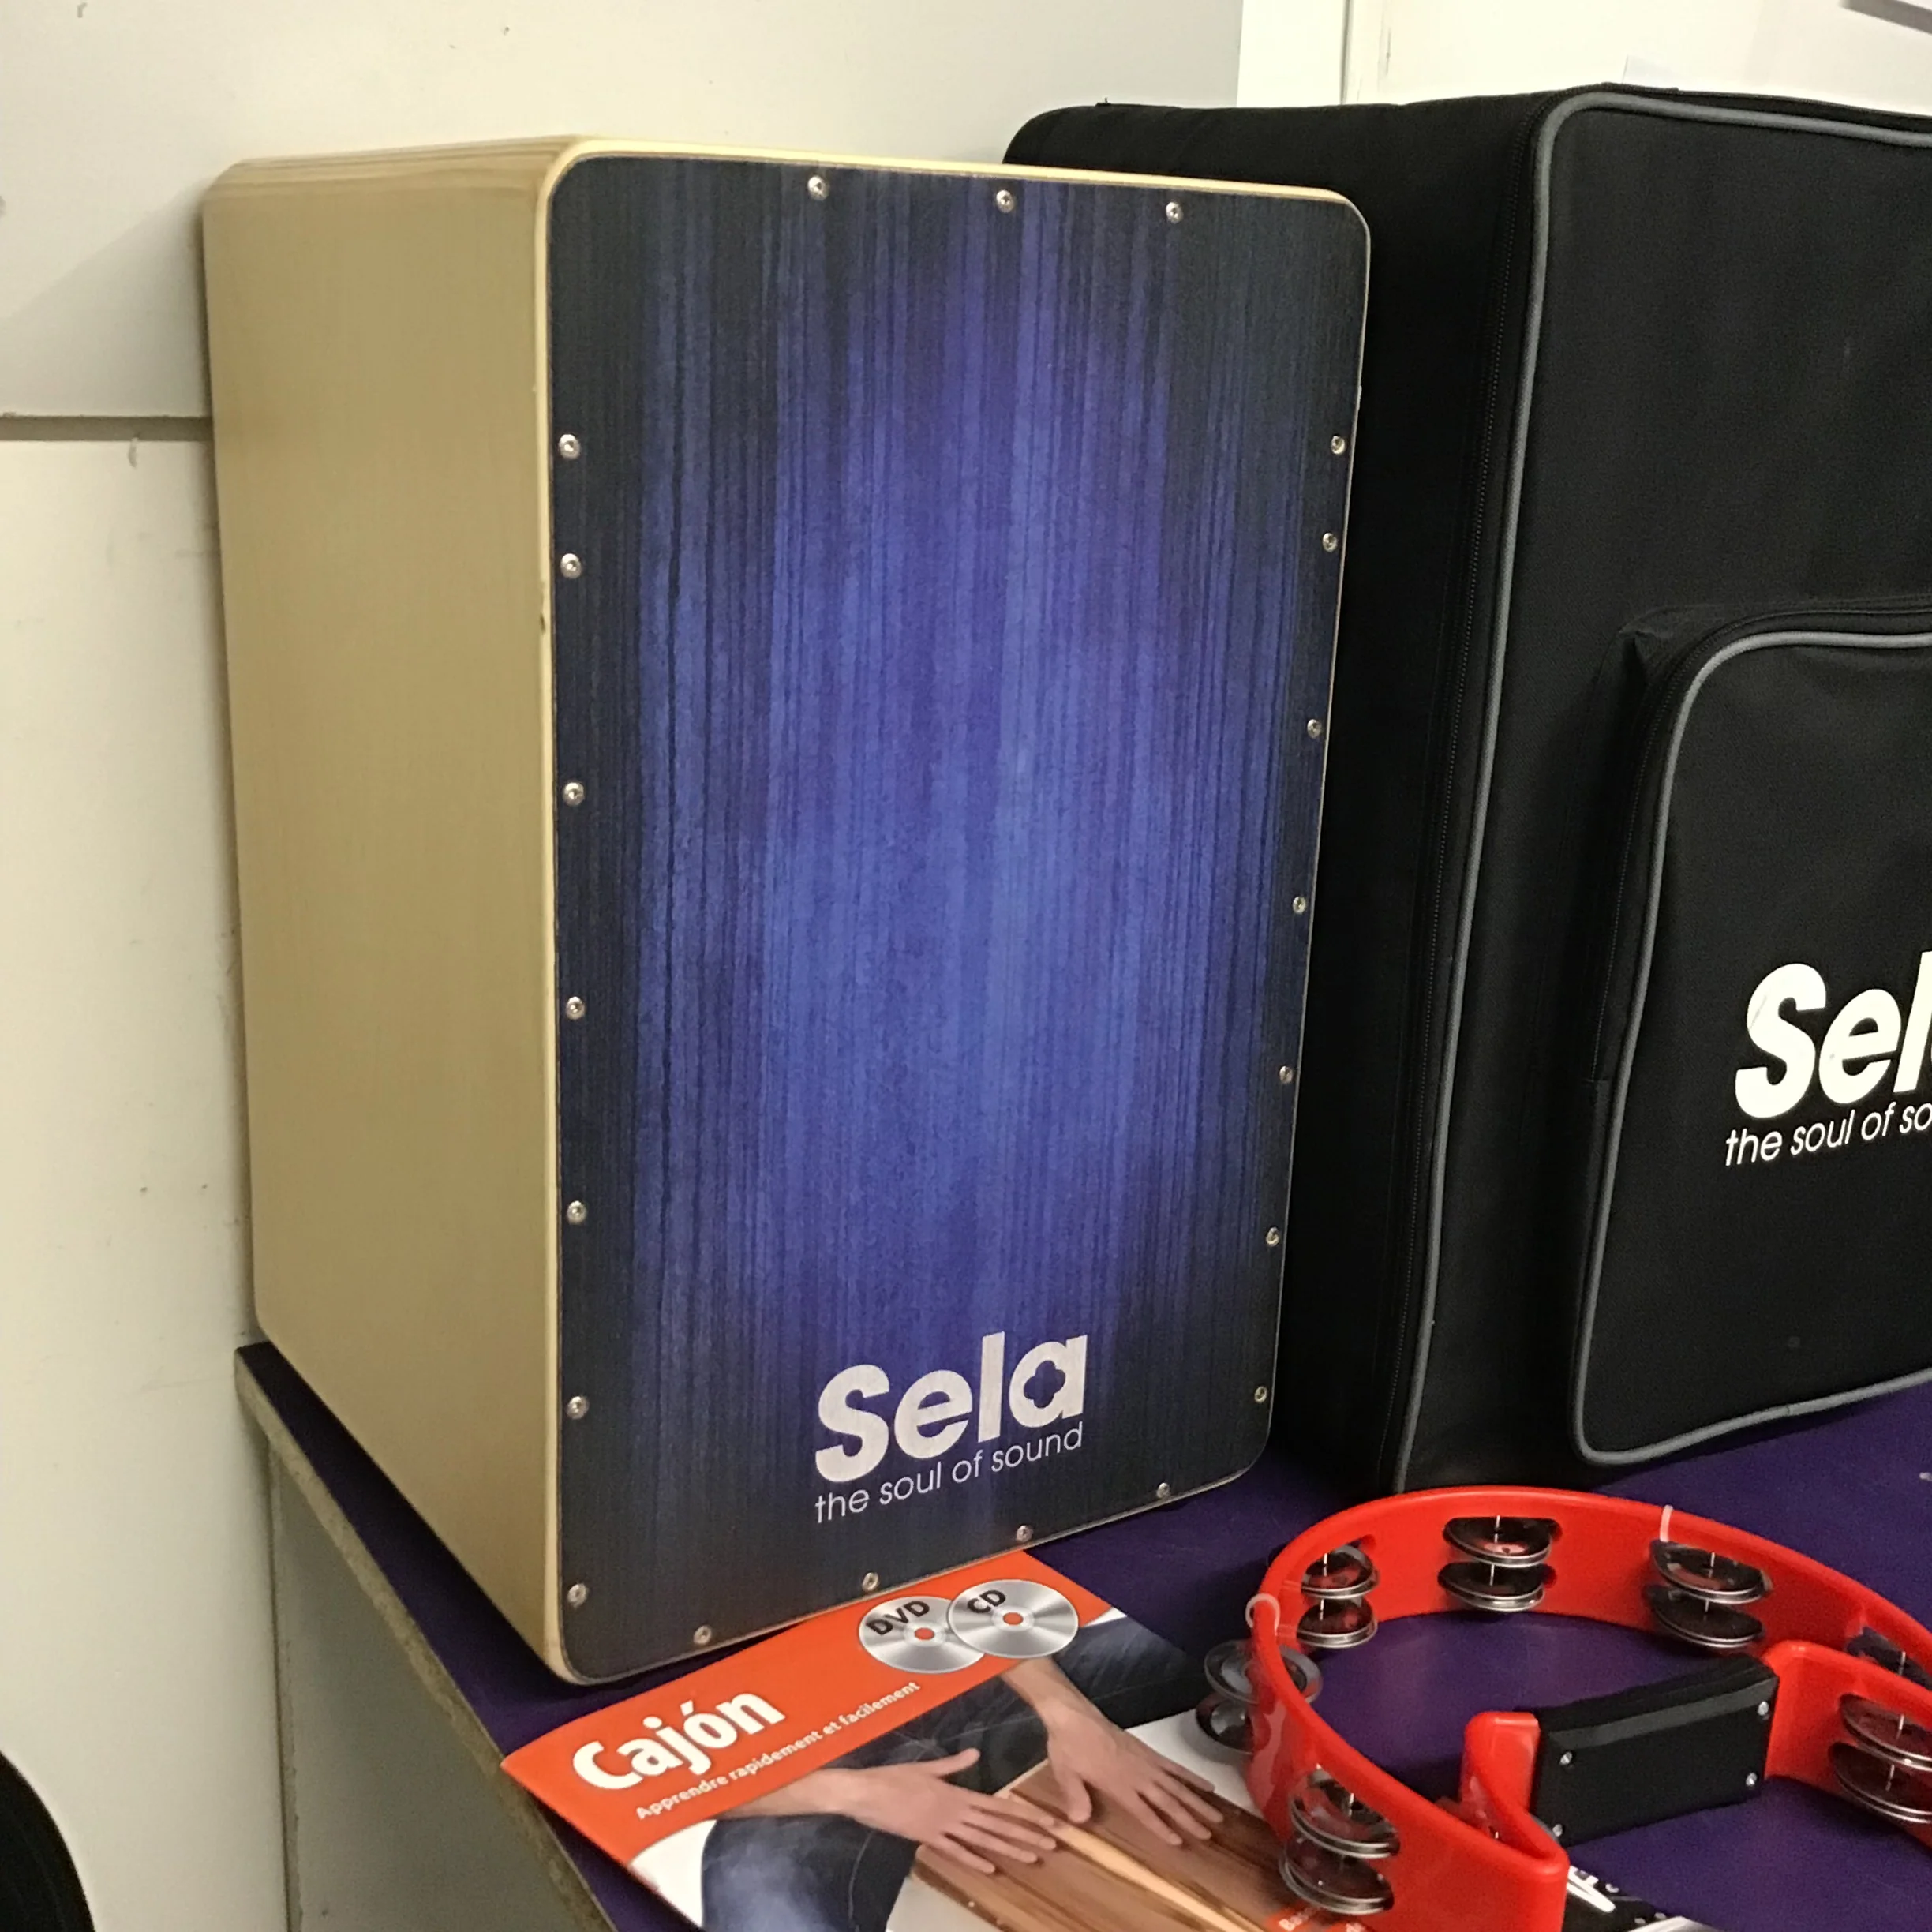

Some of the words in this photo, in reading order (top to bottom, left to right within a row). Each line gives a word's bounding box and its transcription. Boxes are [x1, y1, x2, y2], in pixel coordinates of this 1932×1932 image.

[1735, 951, 1932, 1118] Sel
[1725, 1128, 1783, 1166] the
[1790, 1109, 1855, 1155] soul
[1861, 1101, 1896, 1140] of
[815, 1331, 1088, 1482] Sela
[814, 1489, 870, 1523] the
[879, 1462, 942, 1505] soul
[952, 1450, 983, 1483] of
[991, 1421, 1083, 1472] sound
[867, 1601, 930, 1635] DVD
[967, 1589, 1006, 1614] CD
[573, 1693, 786, 1790] Cajón
[636, 1777, 728, 1819] Apprendre
[728, 1730, 823, 1780] rapidement
[822, 1720, 842, 1735] et
[839, 1681, 920, 1726] facilement
